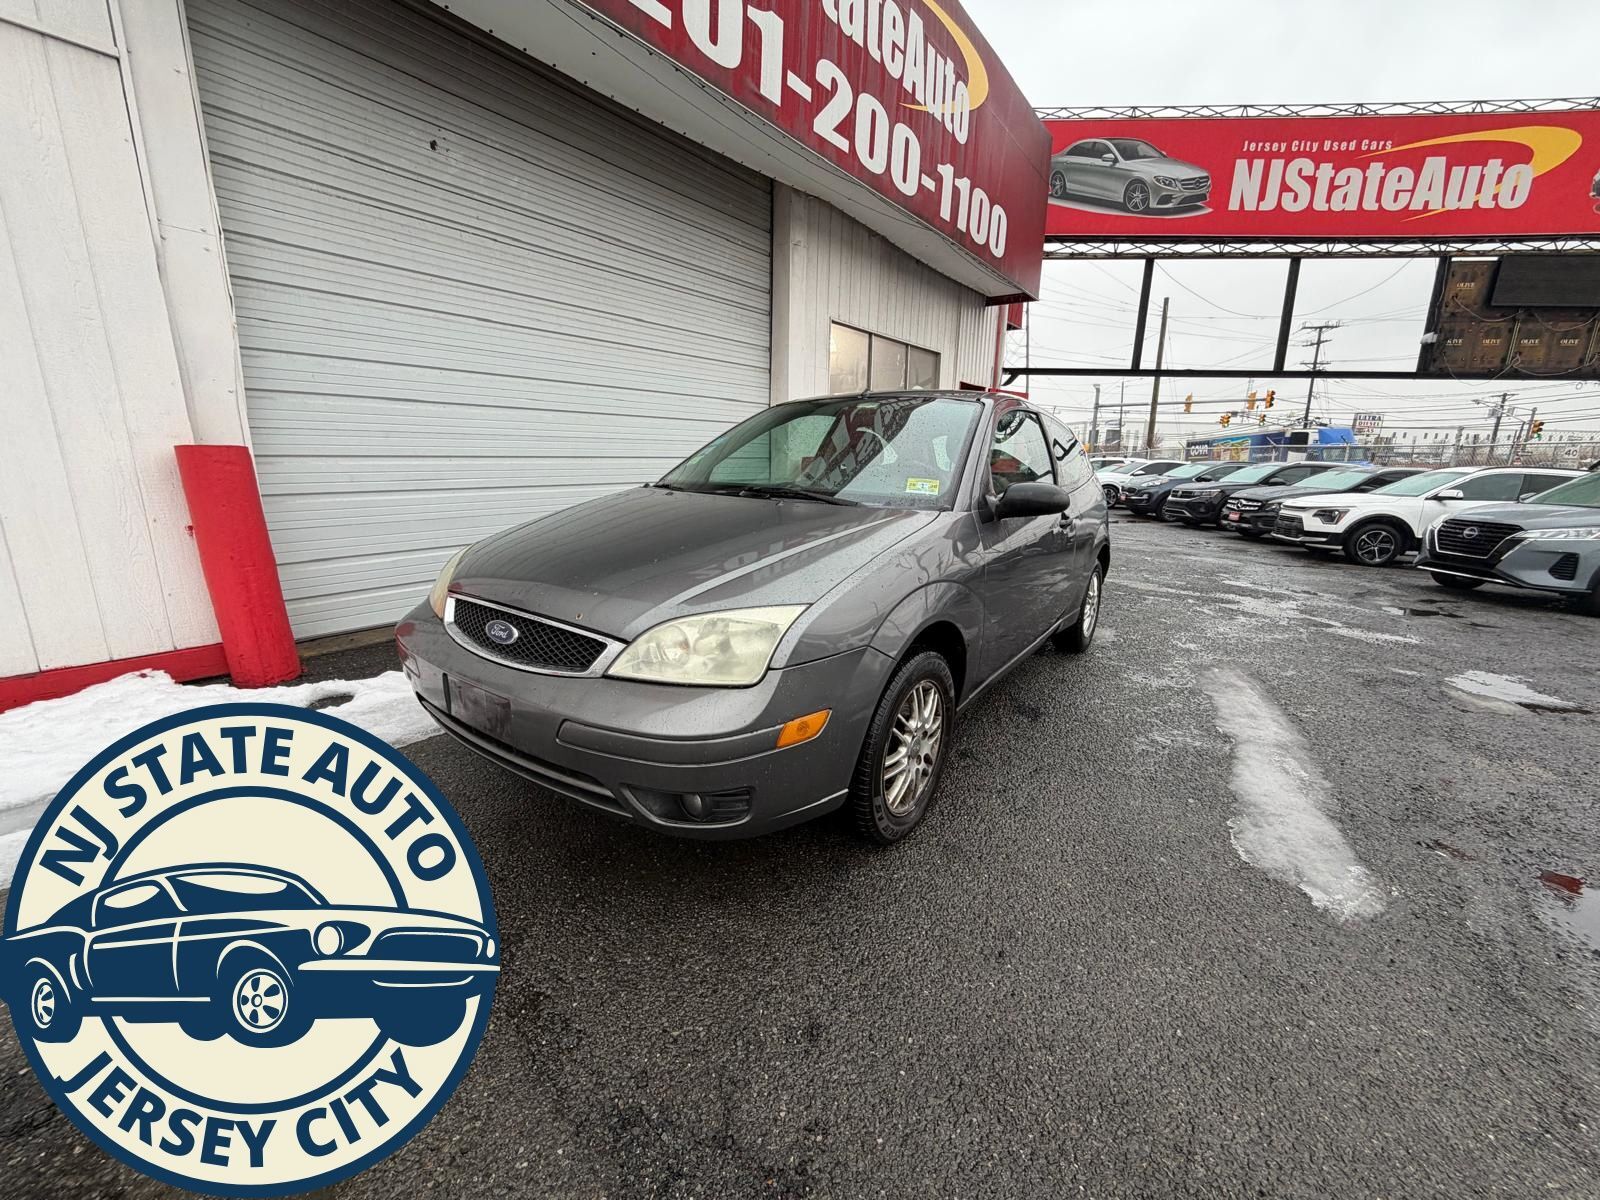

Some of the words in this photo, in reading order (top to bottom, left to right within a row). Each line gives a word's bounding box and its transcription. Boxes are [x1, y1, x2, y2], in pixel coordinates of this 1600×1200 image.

[823, 0, 969, 144] ateAuto
[629, 0, 1007, 258] 01-200-1100
[1243, 140, 1287, 152] Jersey
[1291, 139, 1319, 152] City
[1323, 139, 1357, 151] Used
[1361, 139, 1393, 150] Cars
[1228, 157, 1535, 212] NJStateAuto
[1564, 449, 1578, 457] 40
[491, 623, 509, 639] Ford
